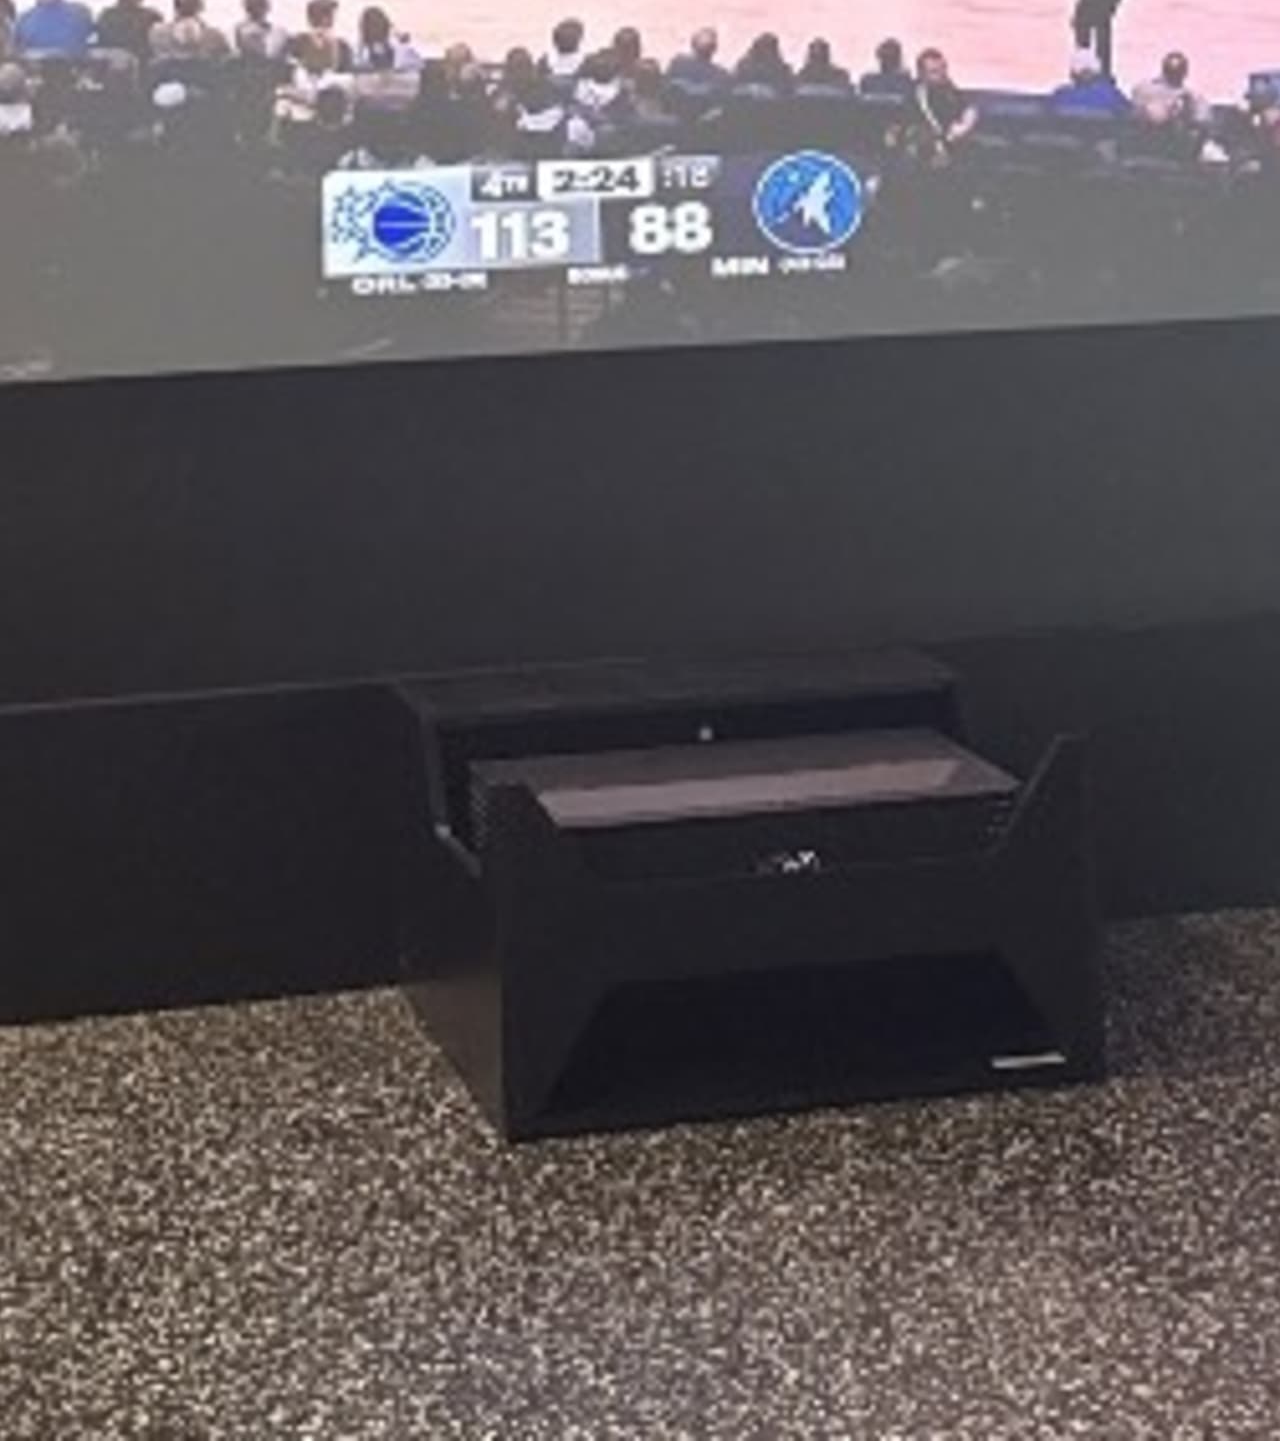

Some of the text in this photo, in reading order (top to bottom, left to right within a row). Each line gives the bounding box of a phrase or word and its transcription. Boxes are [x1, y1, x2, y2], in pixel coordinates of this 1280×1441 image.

[470, 200, 714, 261] 113 88
[710, 256, 768, 277] MIN
[351, 277, 418, 296] ORL
